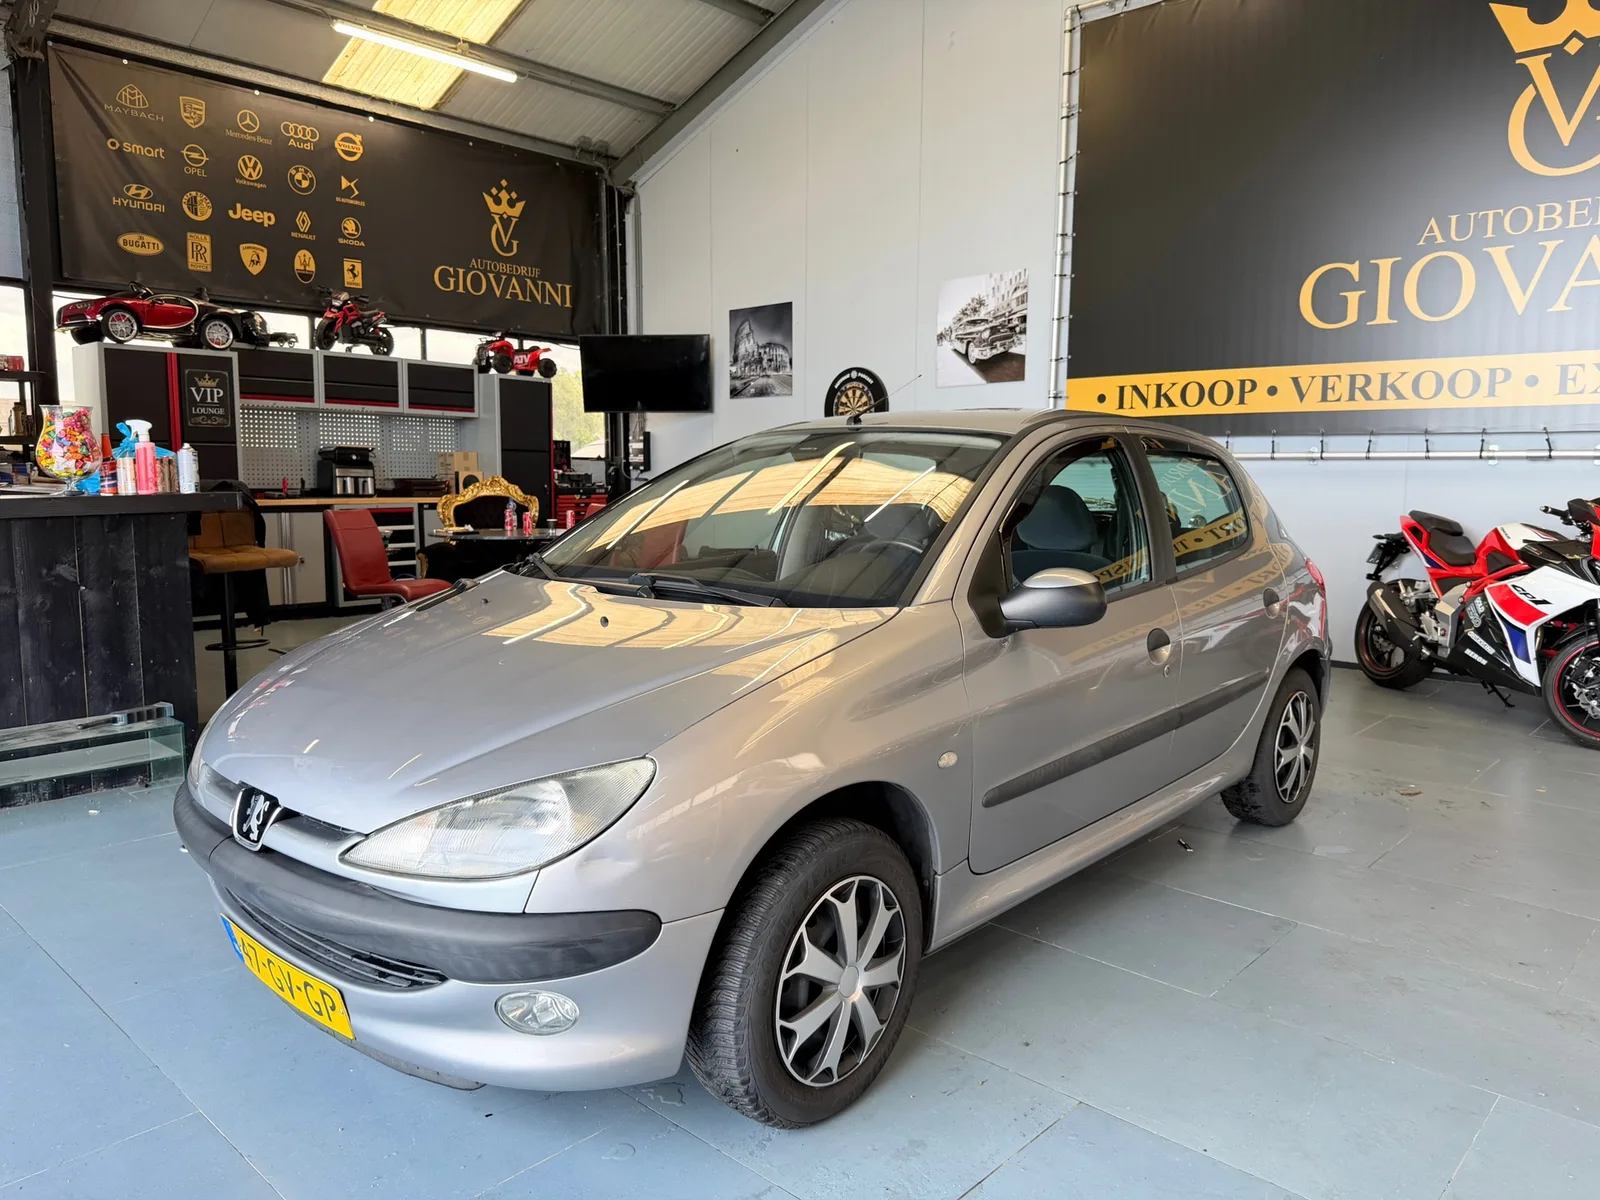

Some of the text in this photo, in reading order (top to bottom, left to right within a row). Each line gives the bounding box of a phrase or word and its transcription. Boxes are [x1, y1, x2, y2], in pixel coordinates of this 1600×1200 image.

[104, 104, 164, 122] MAYBACH
[122, 142, 165, 159] smart
[288, 139, 314, 151] Audi
[338, 143, 361, 151] VOLVO
[183, 166, 207, 177] OPEL
[235, 177, 267, 189] Volkswagen
[112, 197, 165, 213] HYUNDAI
[228, 203, 276, 227] Jeep
[1417, 197, 1600, 246] AUTOBE
[122, 239, 160, 251] BUGATTI
[469, 258, 541, 278] AUTOBEDRIJF
[433, 265, 572, 308] GIOVANNI
[513, 354, 530, 365] ATV
[190, 387, 224, 403] VIP
[1116, 378, 1258, 411] INKOOP
[1289, 367, 1513, 404] VERKOOP
[192, 407, 225, 415] LOUNGE
[240, 937, 336, 1022] 47-GV-GP
